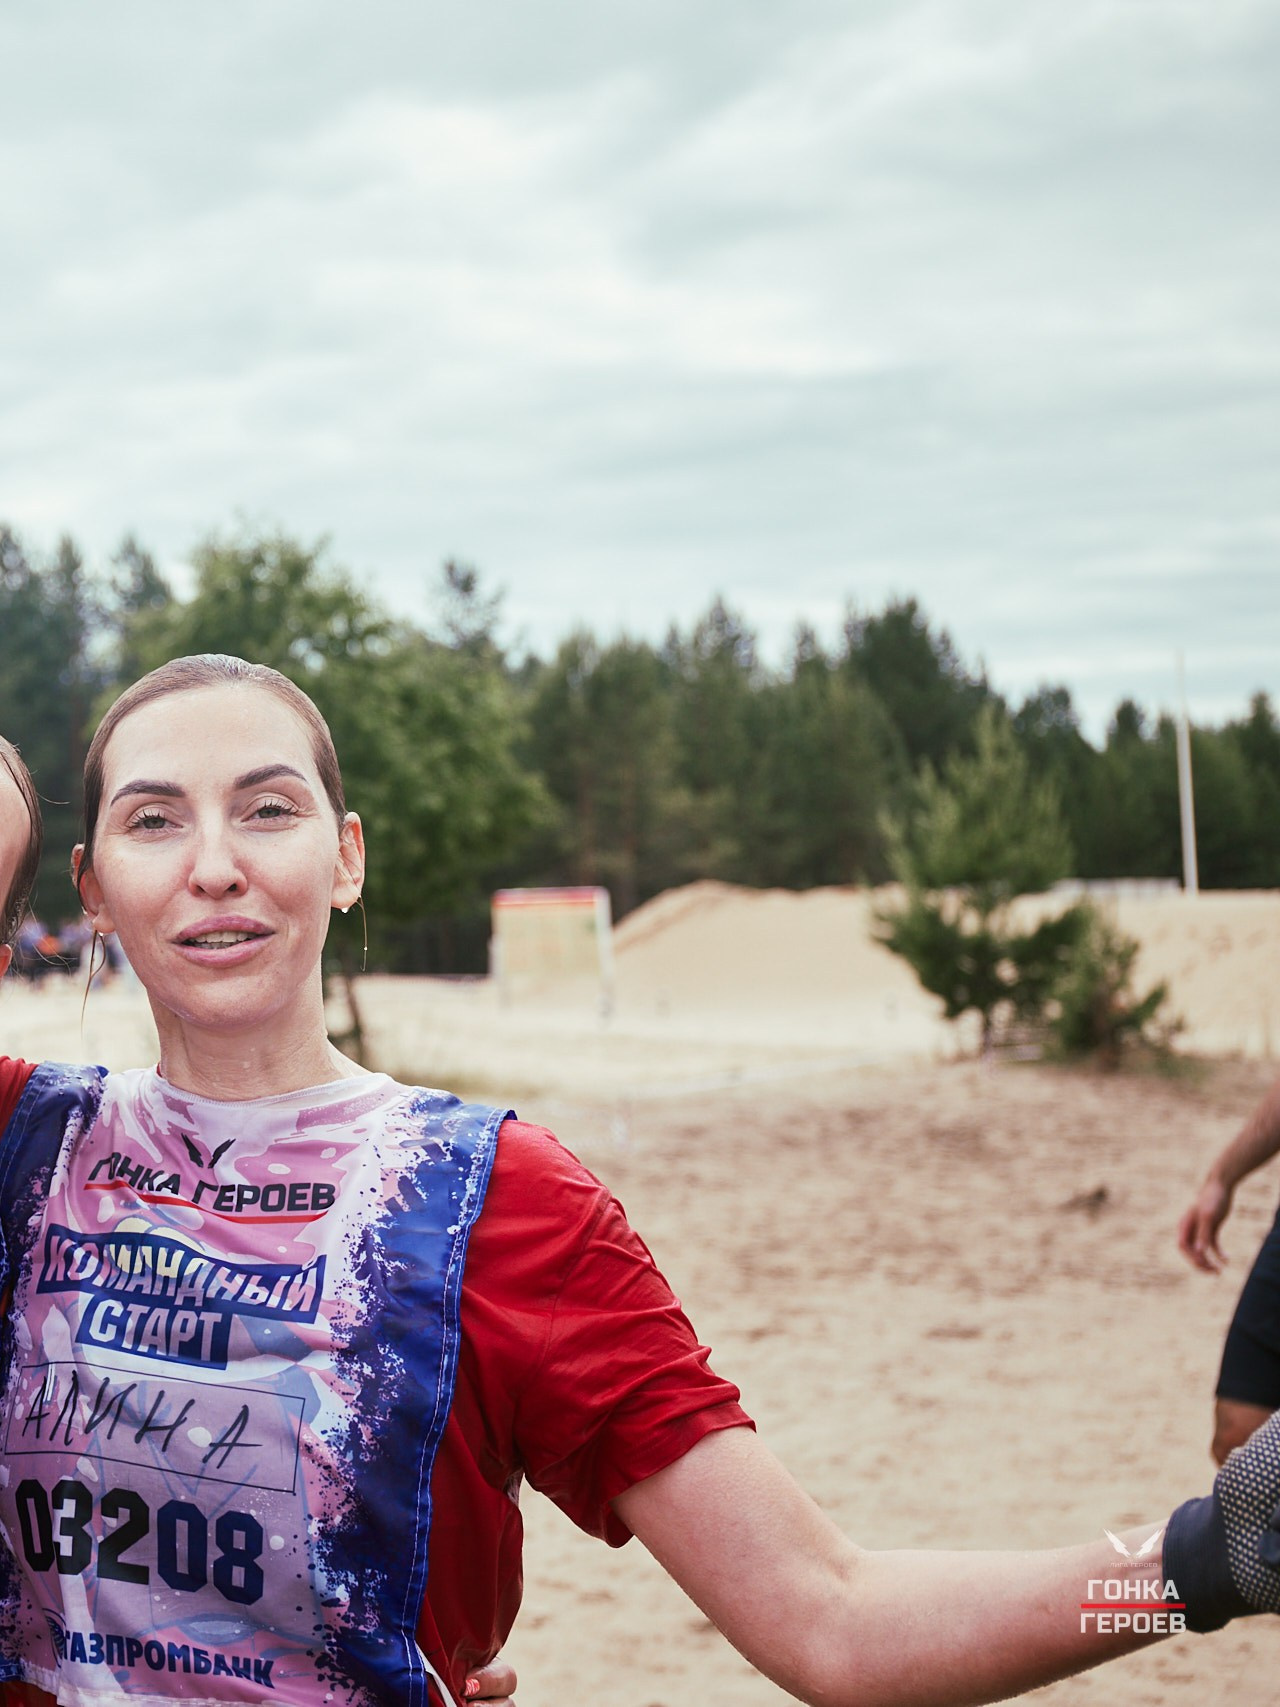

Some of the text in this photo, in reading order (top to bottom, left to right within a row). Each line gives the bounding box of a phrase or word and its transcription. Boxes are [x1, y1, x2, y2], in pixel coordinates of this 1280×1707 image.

[191, 1180, 336, 1212] ГЕРОЕВ
[45, 1235, 317, 1313] КОМАНДНЫЙ
[89, 1299, 222, 1361] СТАРТ
[22, 1369, 263, 1469] АЛИНА
[15, 1478, 263, 1606] 03208
